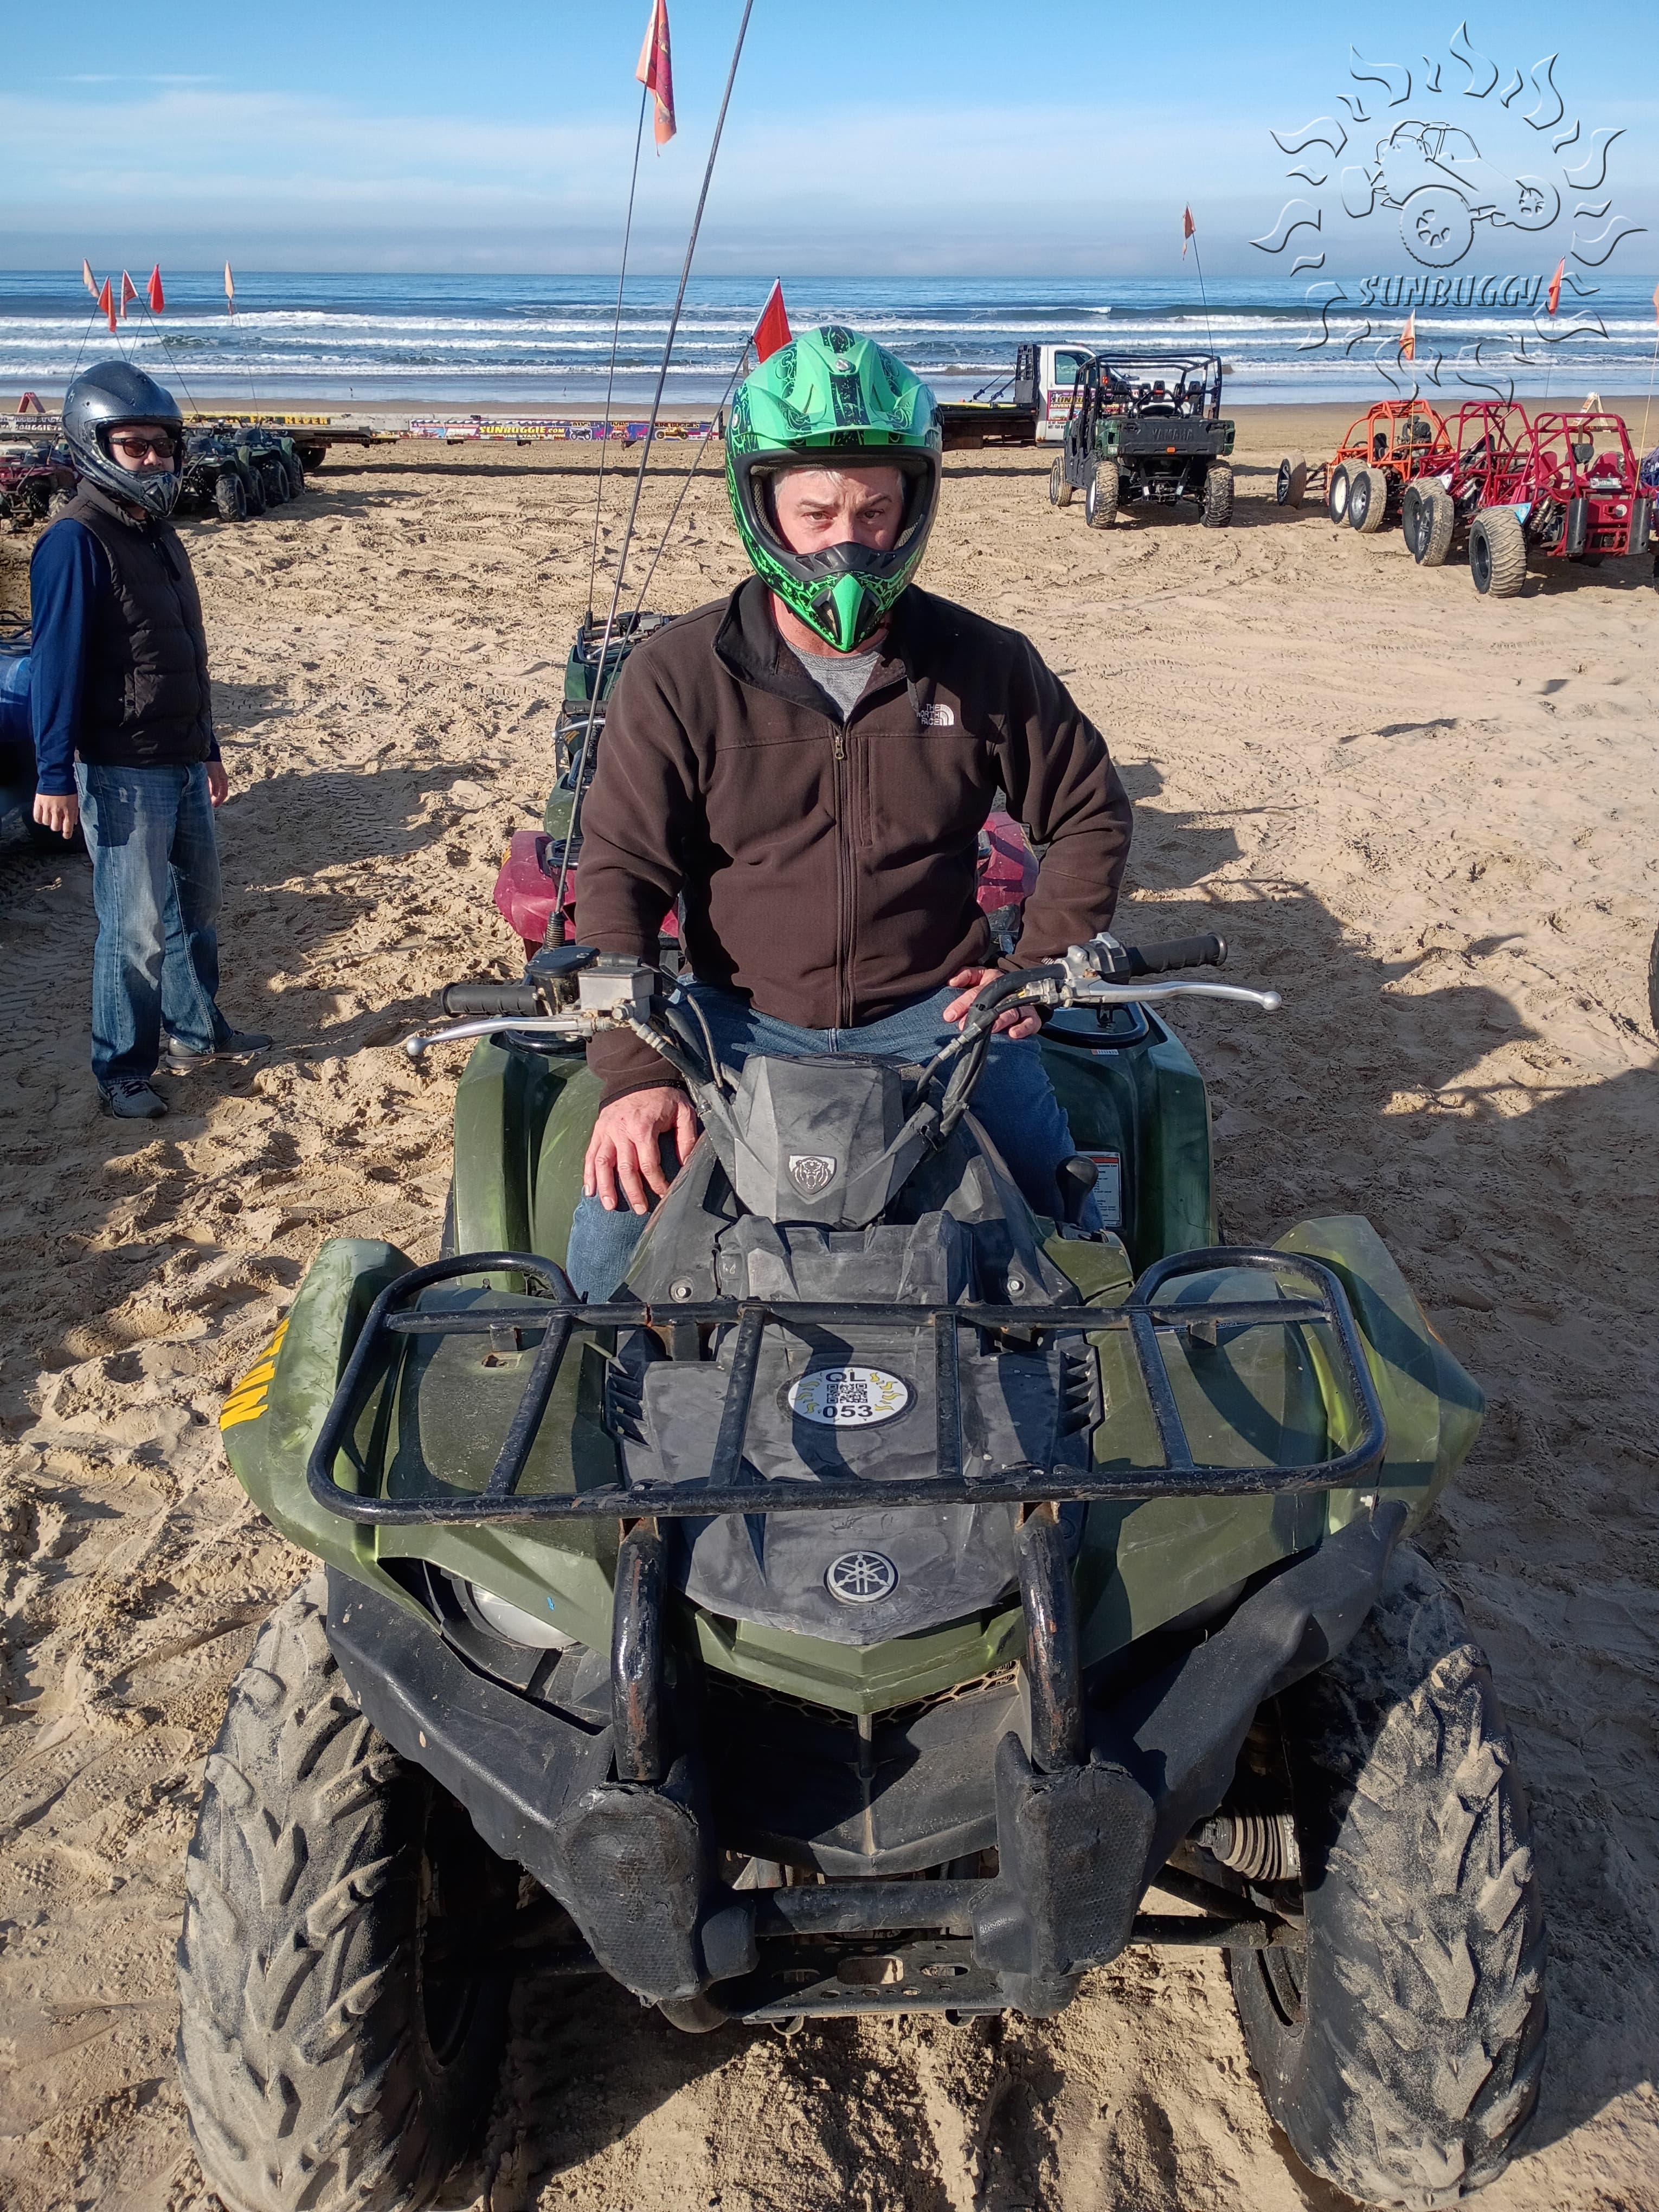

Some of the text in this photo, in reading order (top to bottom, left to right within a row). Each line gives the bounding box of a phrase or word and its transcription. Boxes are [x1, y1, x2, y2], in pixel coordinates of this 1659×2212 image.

[916, 710, 940, 718] NORTH
[826, 1372, 866, 1382] QL
[822, 1405, 873, 1418] 053
